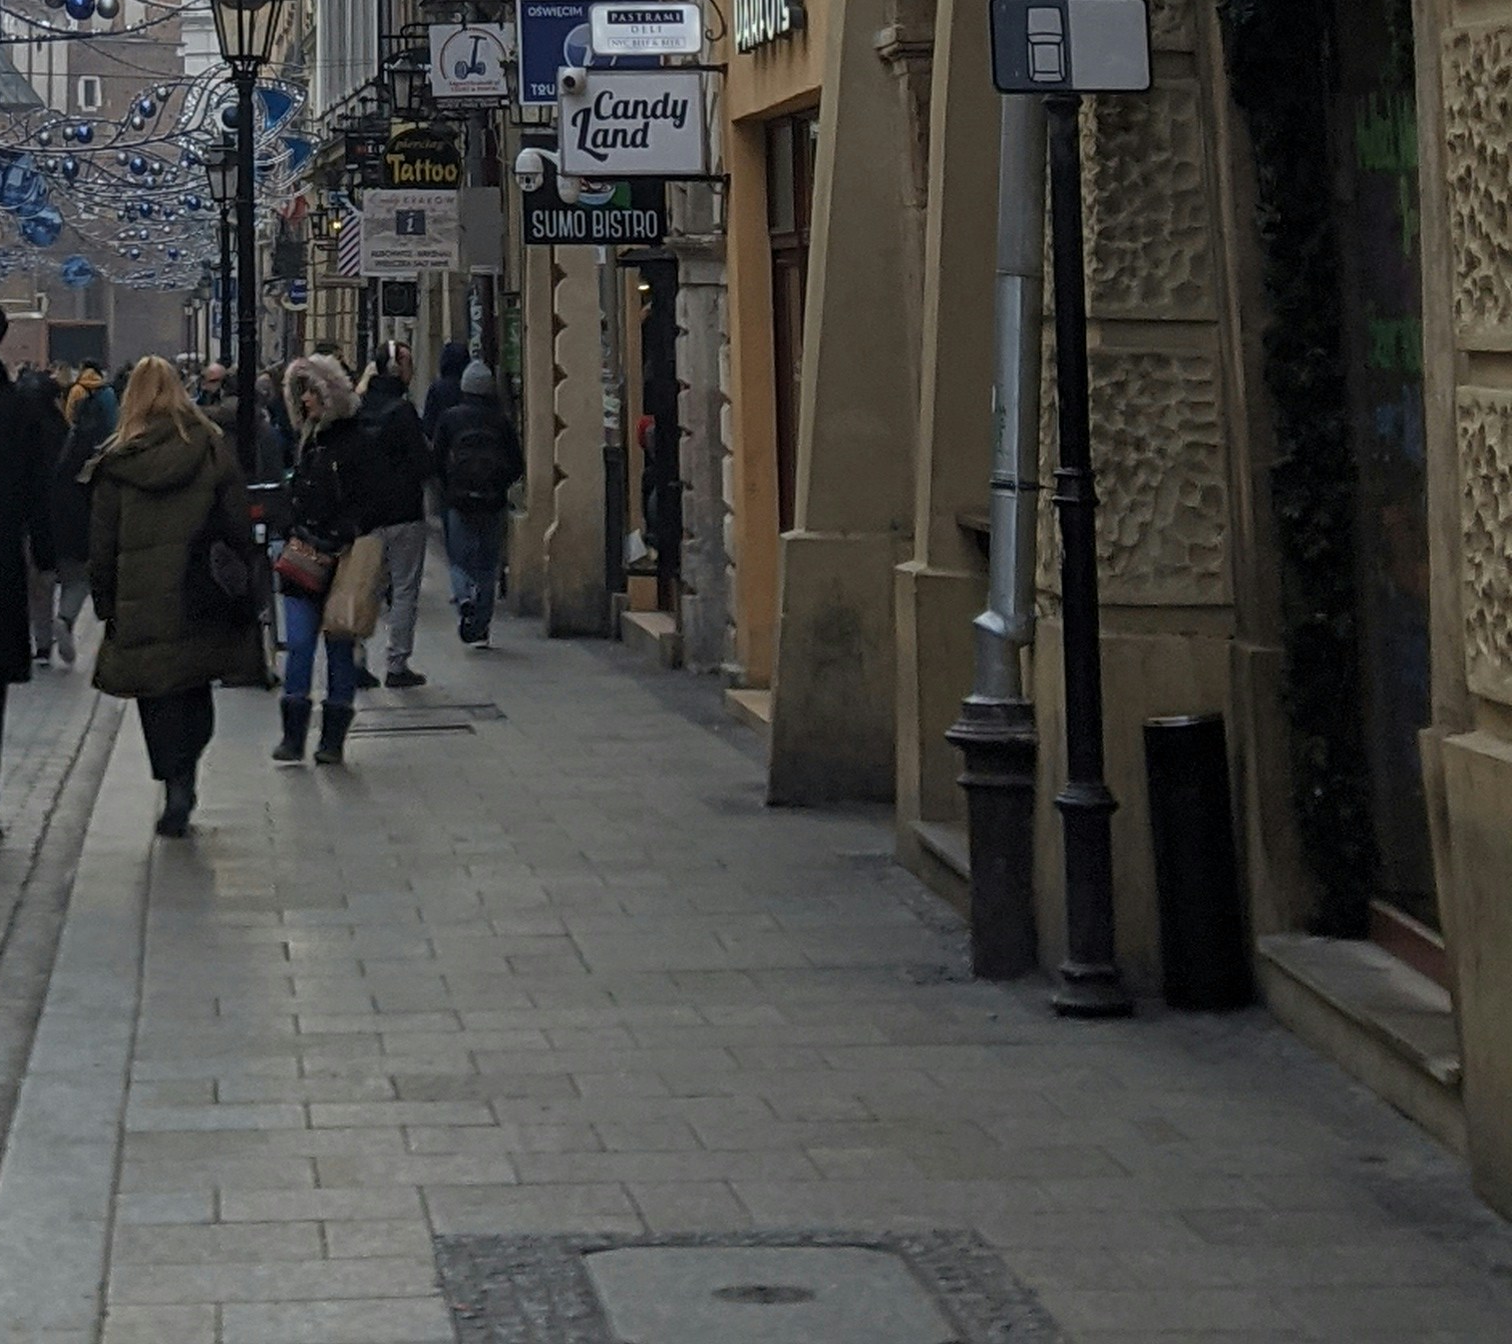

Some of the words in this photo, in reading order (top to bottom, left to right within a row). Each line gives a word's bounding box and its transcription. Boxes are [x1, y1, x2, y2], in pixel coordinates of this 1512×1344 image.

[611, 13, 681, 23] PASTRAMI
[631, 25, 662, 34] DELI
[531, 83, 555, 96] TOU
[594, 90, 688, 129] Candy
[571, 107, 650, 162] Land
[386, 153, 458, 184] Tattoo
[532, 210, 586, 238] SUMO
[592, 210, 658, 238] BISTRO
